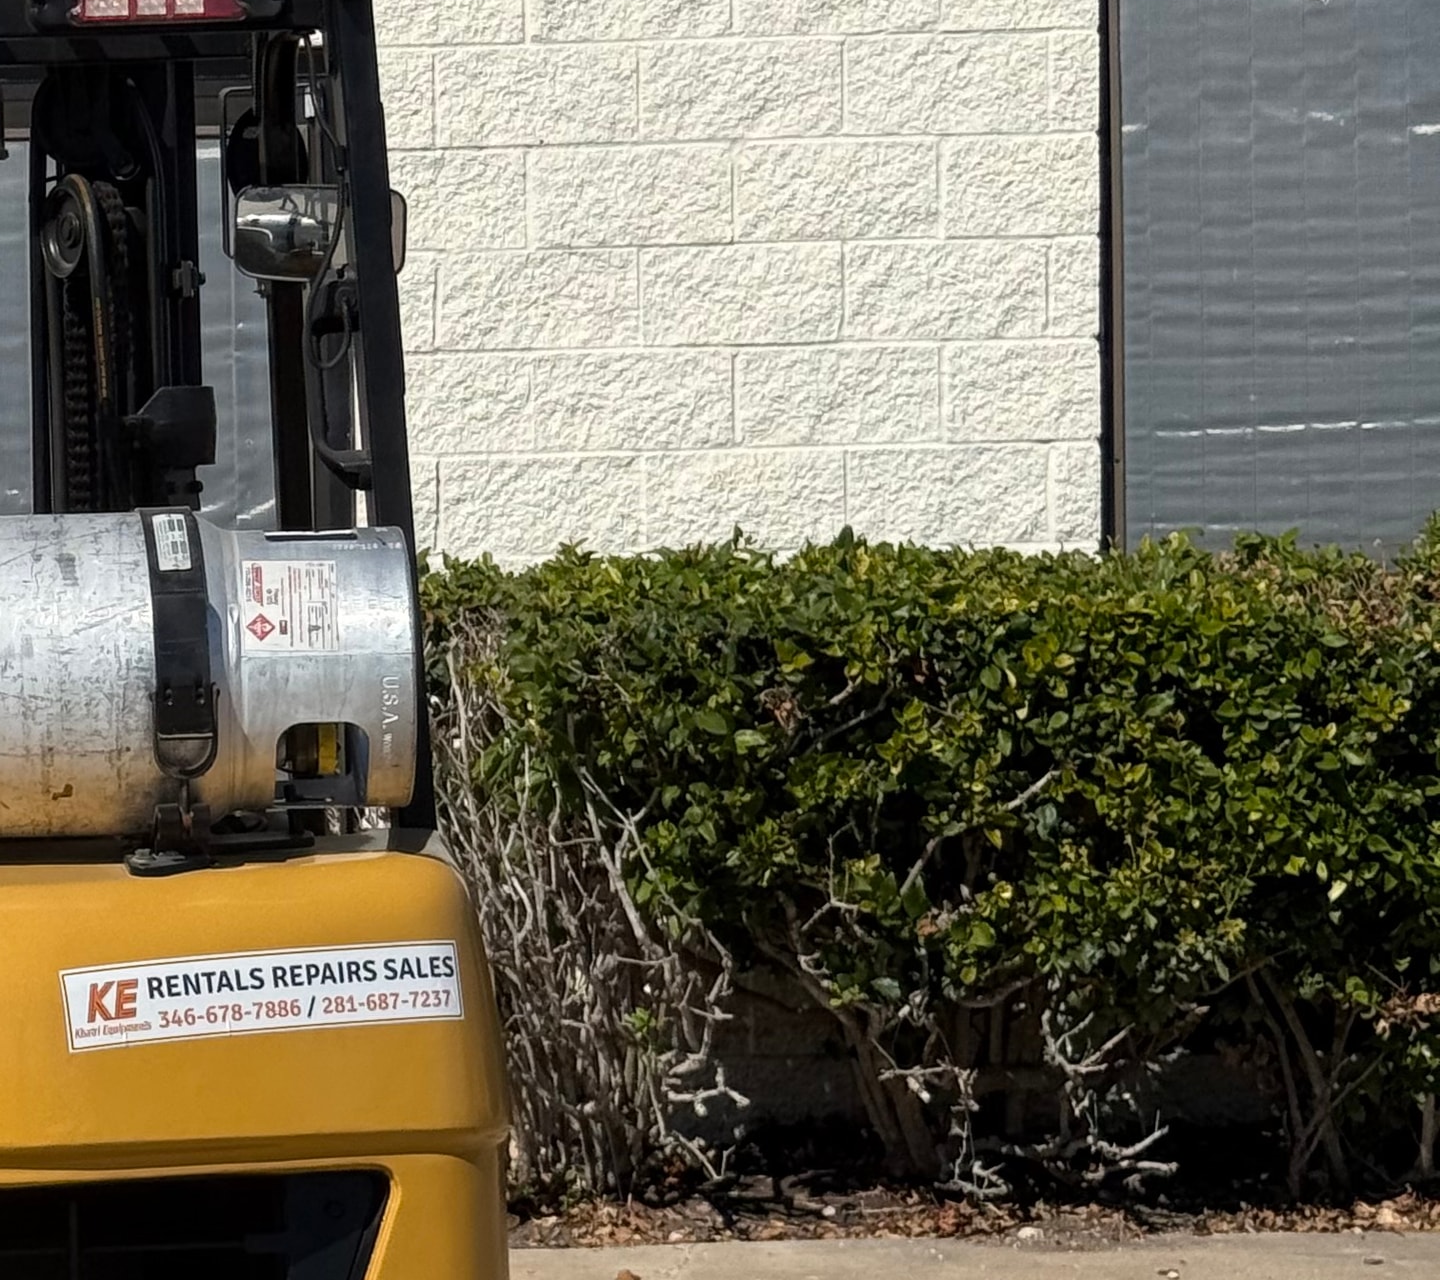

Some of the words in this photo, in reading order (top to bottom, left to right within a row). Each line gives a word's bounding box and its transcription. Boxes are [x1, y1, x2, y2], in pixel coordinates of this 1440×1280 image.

[147, 968, 265, 999] RENTALS
[272, 960, 377, 988] REPAIRS
[383, 956, 454, 981] SALES
[87, 978, 139, 1023] KE
[158, 999, 302, 1028] 346-678-7886
[307, 995, 316, 1018] /
[322, 989, 451, 1015] 281-687-7237
